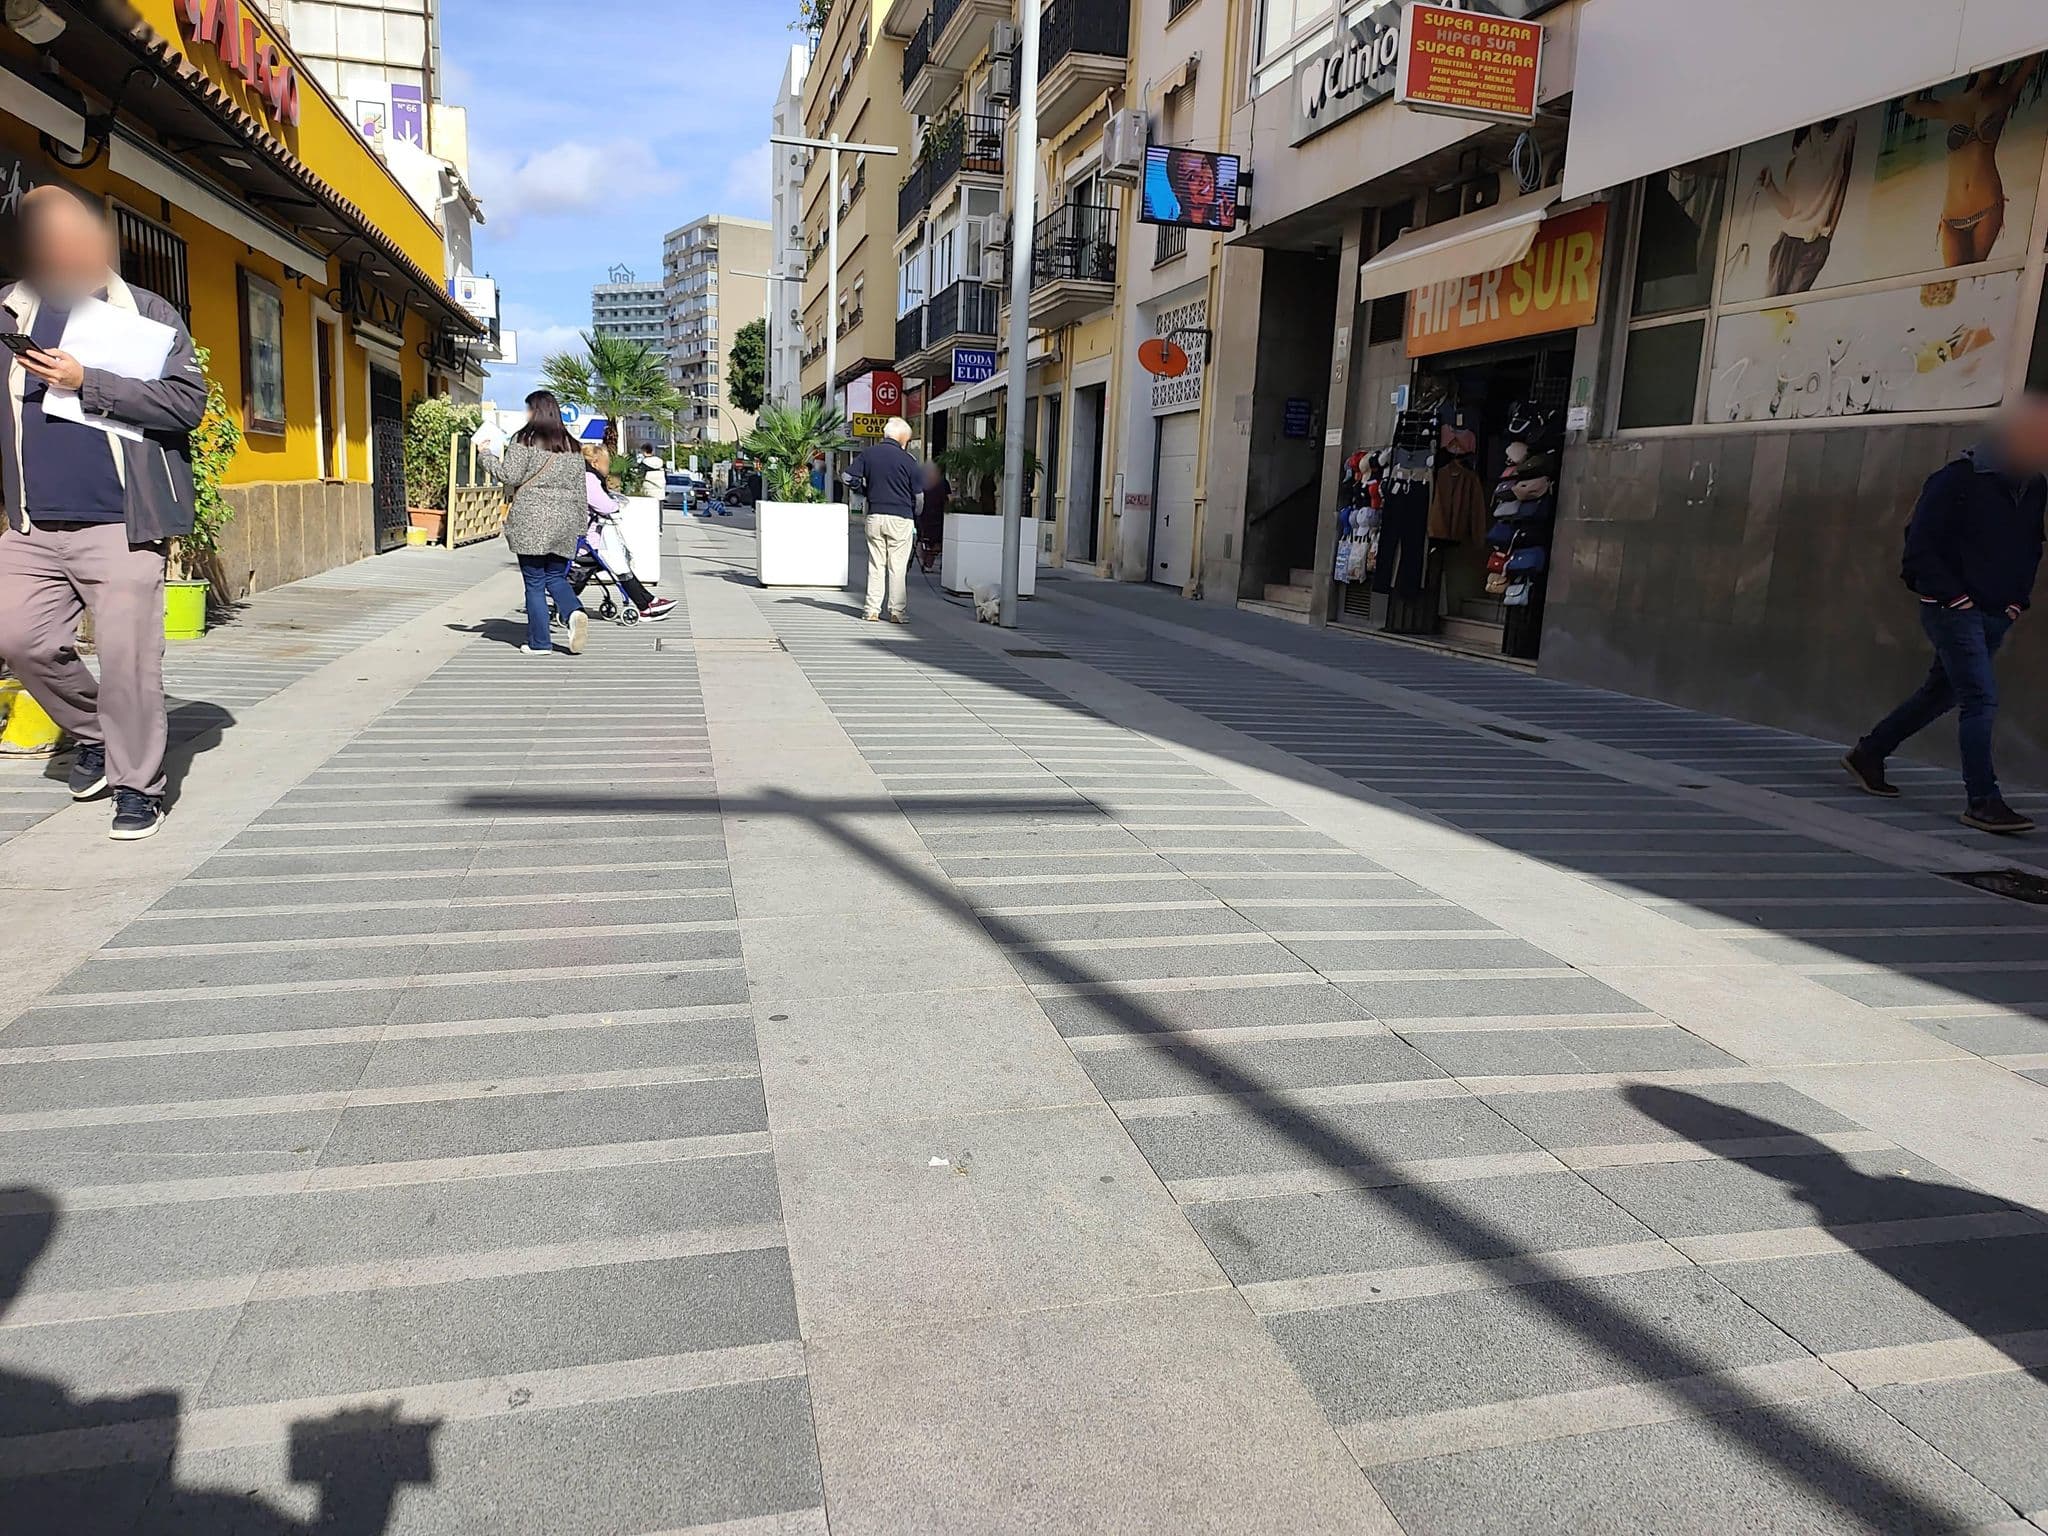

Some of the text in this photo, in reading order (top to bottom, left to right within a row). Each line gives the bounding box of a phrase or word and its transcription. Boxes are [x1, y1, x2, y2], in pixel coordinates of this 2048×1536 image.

[1424, 12, 1531, 41] SUPER BAZAR
[1437, 29, 1516, 52] HIPER SUR
[1416, 40, 1534, 68] SUPER BAZAAR
[1429, 75, 1451, 86] MODA
[406, 104, 417, 112] 66
[1413, 231, 1595, 338] HIPER SUR
[958, 353, 993, 365] MODA
[957, 366, 992, 380] ELIM
[878, 387, 895, 399] GE
